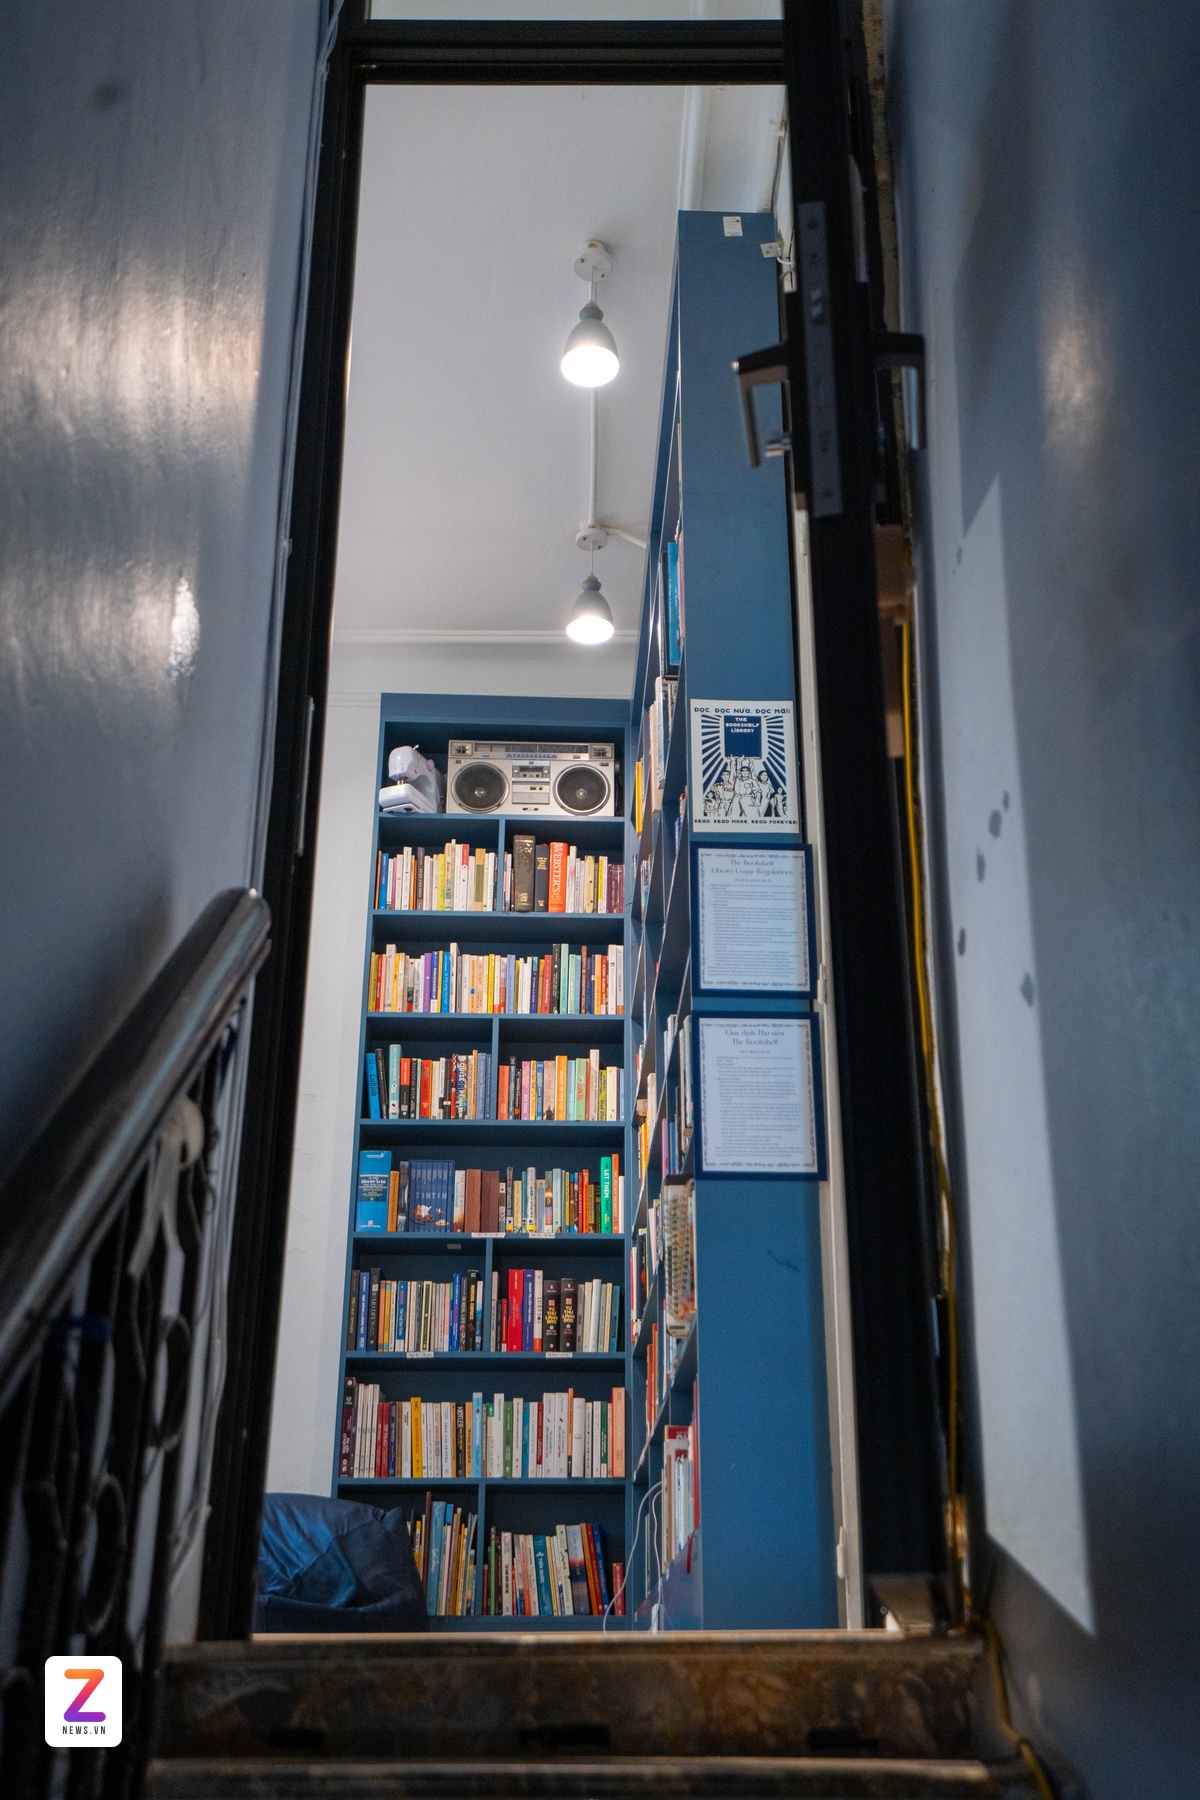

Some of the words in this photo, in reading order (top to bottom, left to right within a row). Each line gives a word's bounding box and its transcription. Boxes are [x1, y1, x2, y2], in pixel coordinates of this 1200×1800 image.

[735, 868, 754, 876] Usage
[756, 868, 794, 876] Regulations
[415, 1192, 448, 1200] TINTIN
